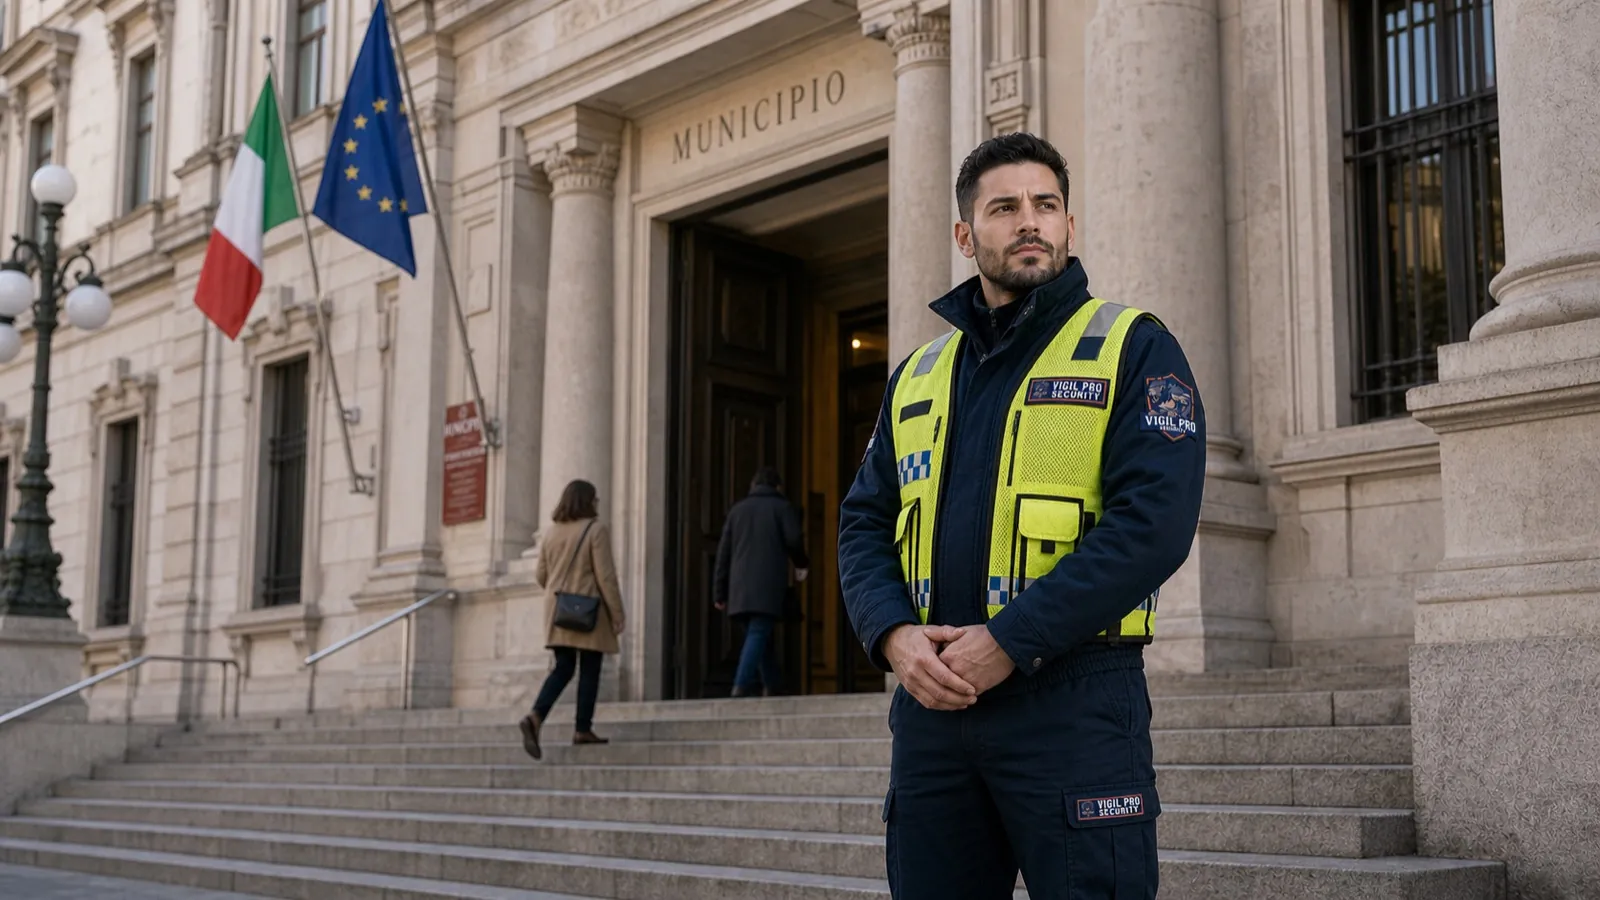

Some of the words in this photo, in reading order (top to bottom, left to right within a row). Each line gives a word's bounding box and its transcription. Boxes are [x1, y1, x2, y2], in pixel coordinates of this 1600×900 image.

[672, 69, 845, 164] MUNICIPIO
[1052, 381, 1078, 392] VIGIL
[1082, 382, 1102, 393] PRO
[1051, 390, 1101, 401] SECURITY
[1145, 415, 1176, 427] VIGIL
[1178, 418, 1196, 433] PRO
[1097, 799, 1122, 809] VIGIL
[1123, 796, 1140, 807] PRO
[1099, 806, 1139, 817] SECURITY
